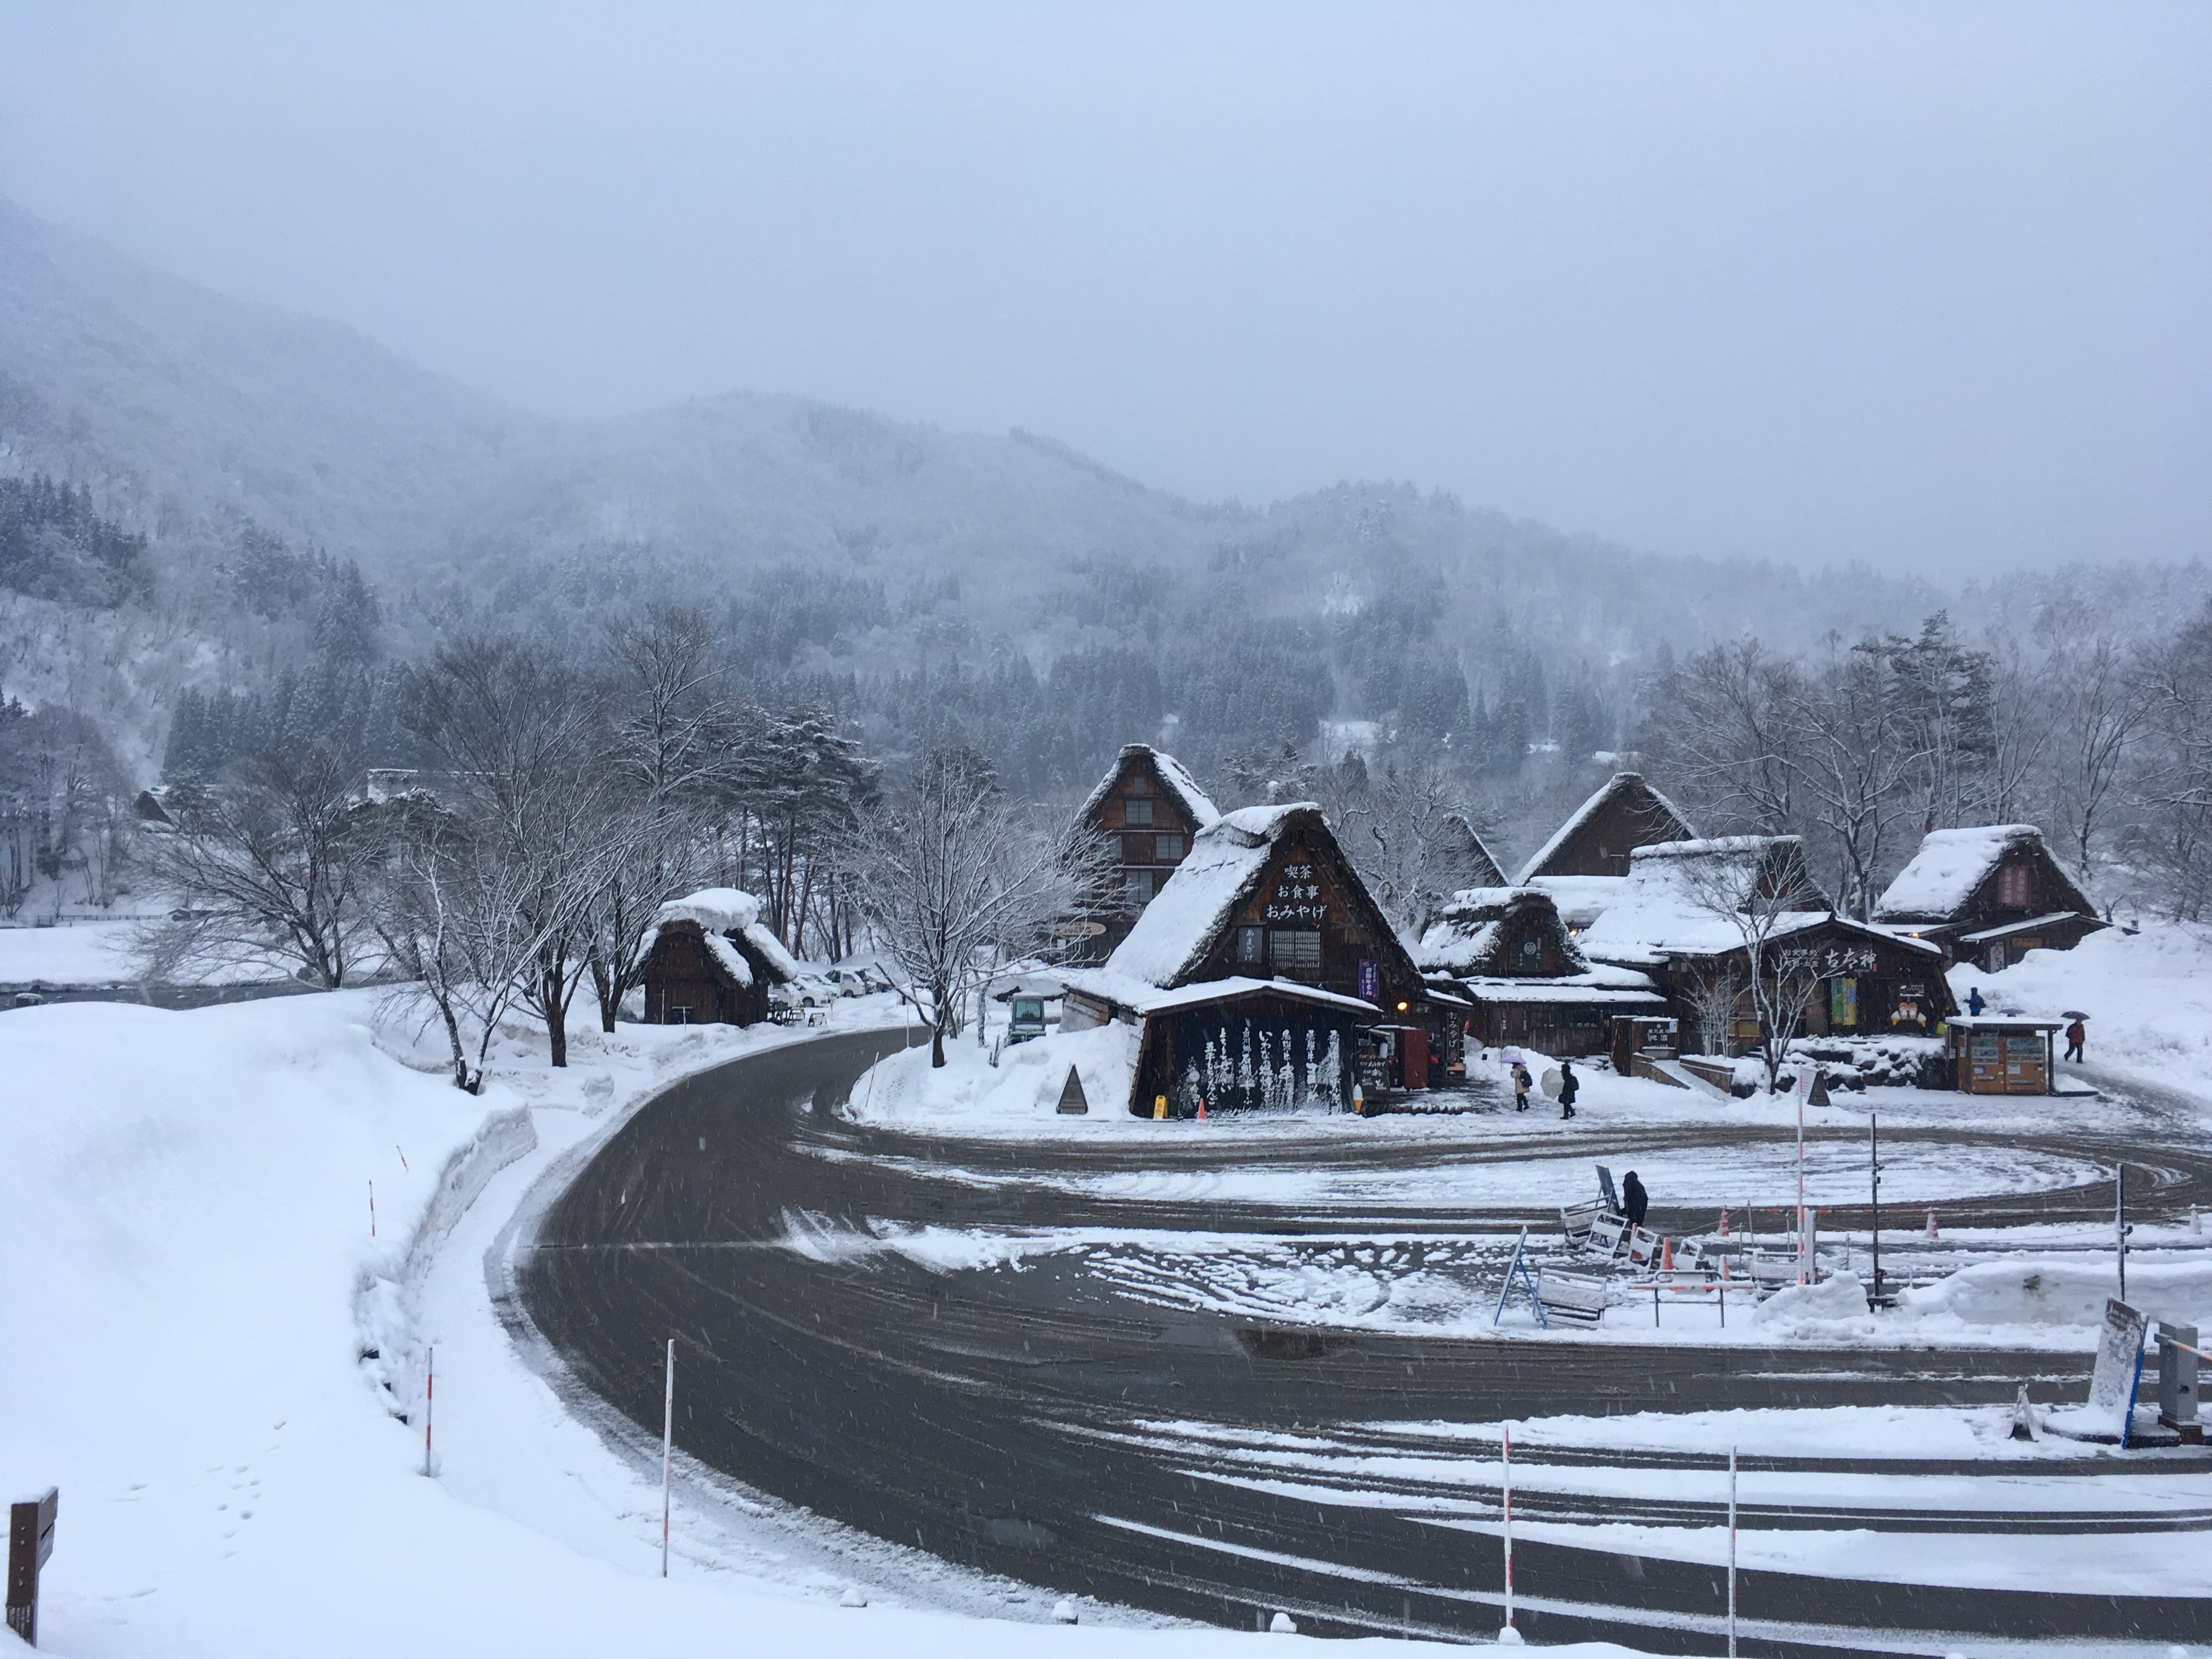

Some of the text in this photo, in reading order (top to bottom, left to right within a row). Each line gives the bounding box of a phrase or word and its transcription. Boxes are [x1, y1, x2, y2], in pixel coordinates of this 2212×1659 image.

[1284, 864, 1312, 879] 喫茶
[1278, 884, 1319, 900] お食事
[1267, 904, 1327, 919] おみやげ
[1245, 929, 1255, 961] あまざけ
[1449, 1012, 1458, 1048] おみやげ
